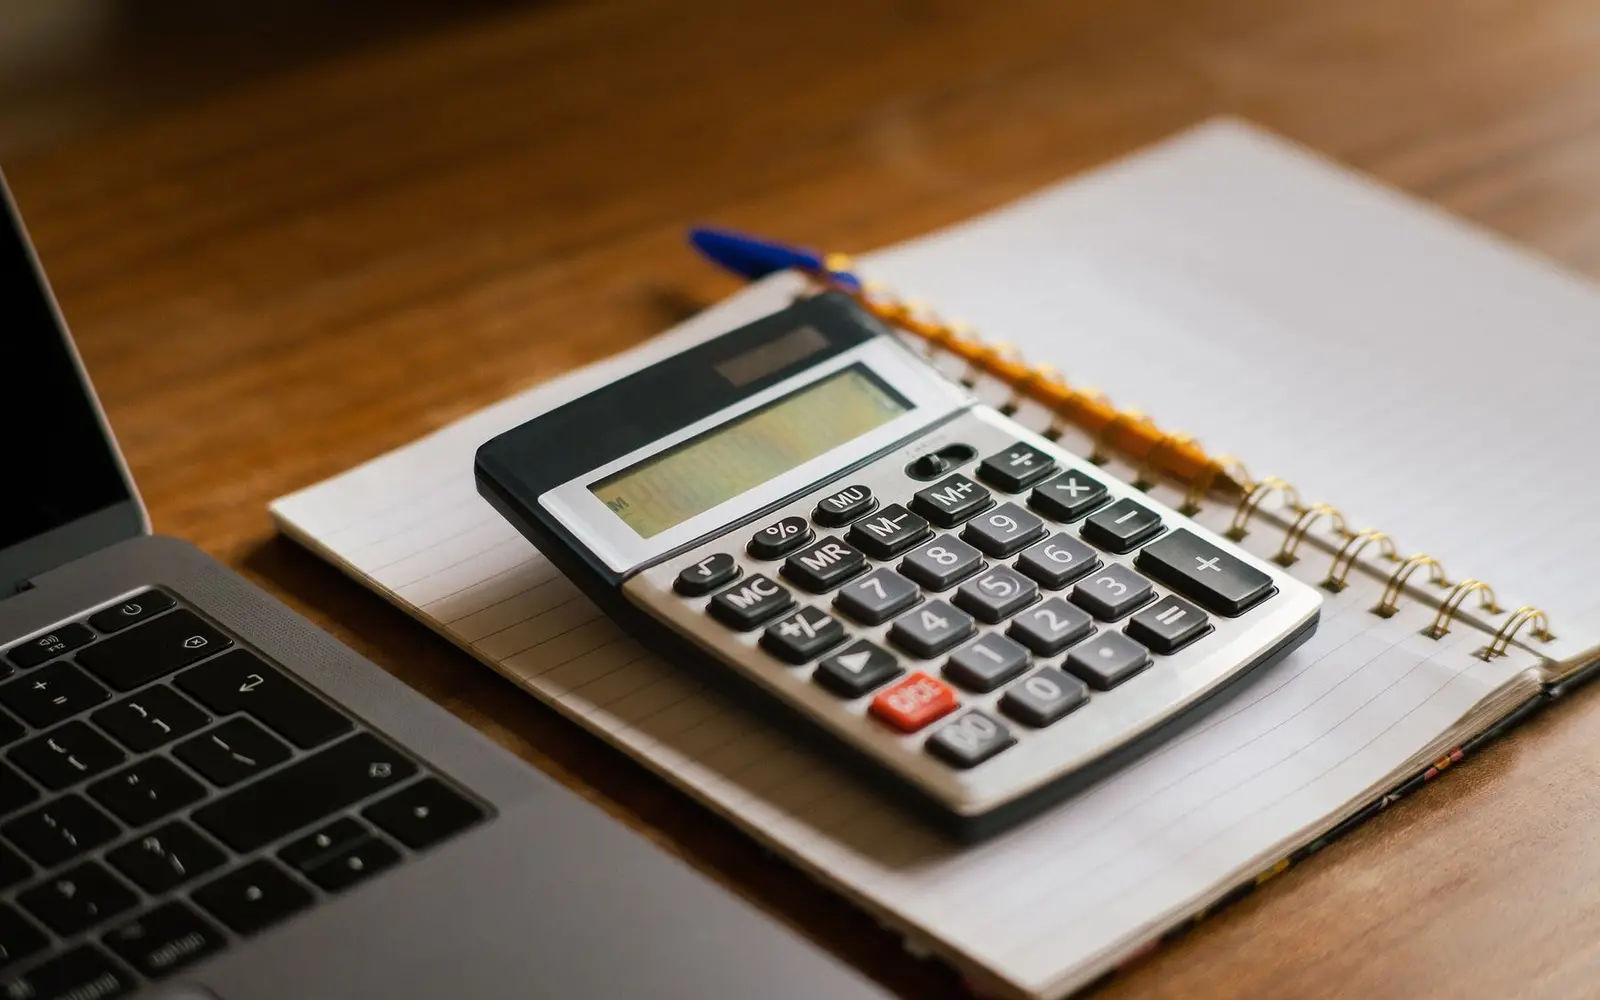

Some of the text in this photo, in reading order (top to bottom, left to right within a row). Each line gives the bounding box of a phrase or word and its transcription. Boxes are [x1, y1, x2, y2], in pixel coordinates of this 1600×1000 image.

[828, 488, 864, 509] MU
[931, 480, 974, 506] M+
[989, 514, 1019, 533] 9
[800, 542, 851, 572] MR
[926, 546, 959, 566] 8
[1042, 544, 1073, 563] 6
[726, 577, 779, 610] MC
[859, 577, 888, 600] 7
[980, 575, 1013, 596] 5
[1096, 576, 1127, 597] 3
[920, 609, 949, 632] 4
[1034, 609, 1071, 631] 2
[971, 644, 1005, 663] 1
[1025, 676, 1061, 700] 0
